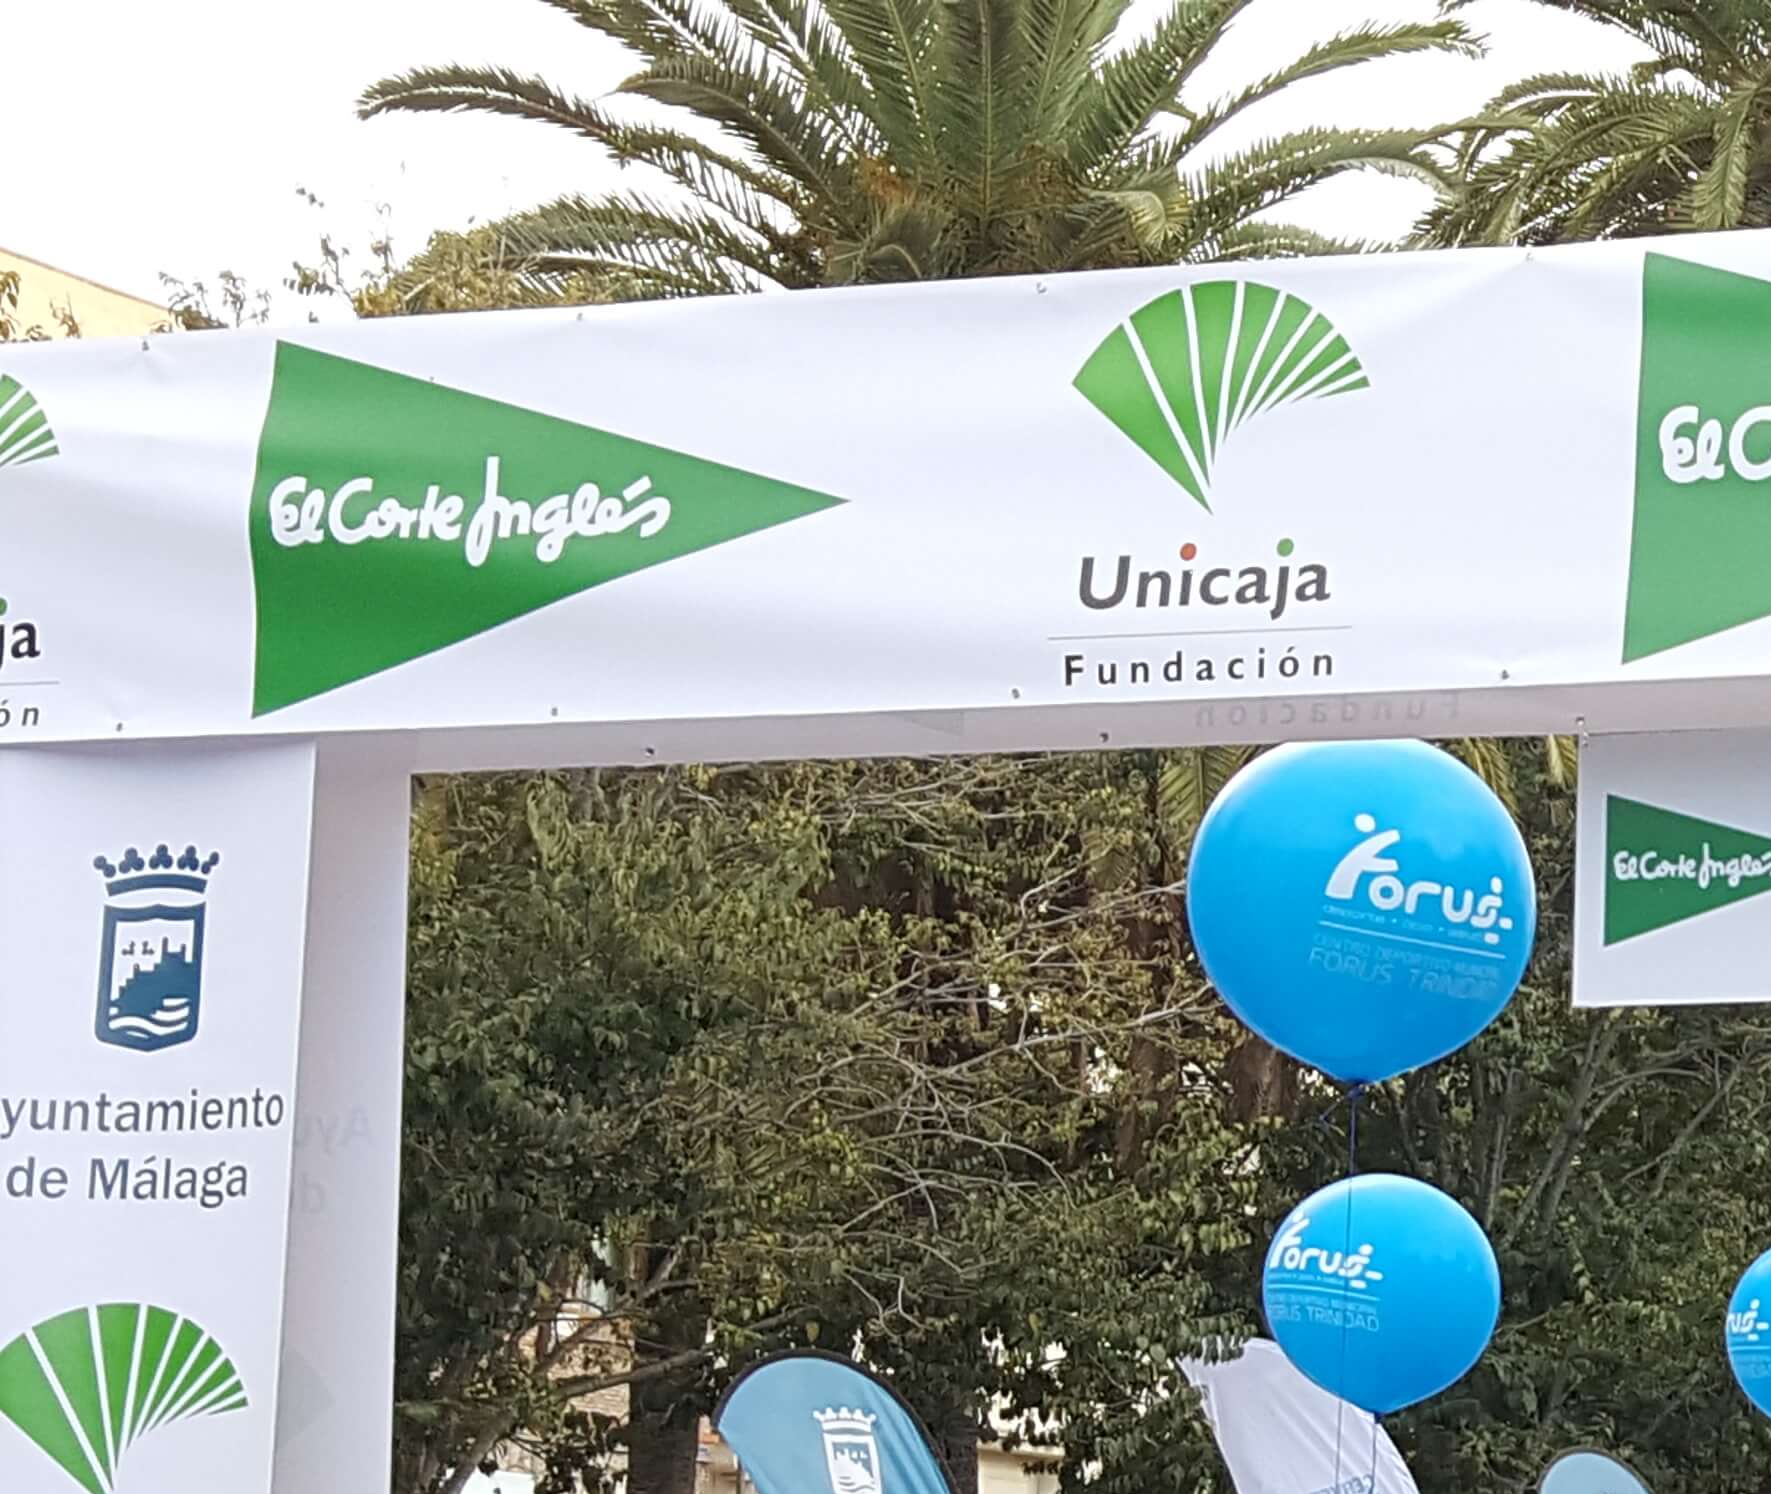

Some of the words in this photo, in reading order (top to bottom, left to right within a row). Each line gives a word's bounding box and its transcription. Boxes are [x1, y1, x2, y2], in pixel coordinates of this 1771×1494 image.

[1660, 406, 1723, 484] El
[269, 476, 324, 547] El
[328, 477, 462, 544] Corte
[465, 456, 670, 567] Inglés
[1078, 538, 1331, 620] Unicaja
[1064, 646, 1333, 686] Fundación
[1613, 851, 1638, 881] El
[1640, 852, 1697, 880] Corte
[0, 1088, 284, 1139] yuntamiento
[6, 1156, 69, 1198] de
[88, 1155, 248, 1208] Málaga
